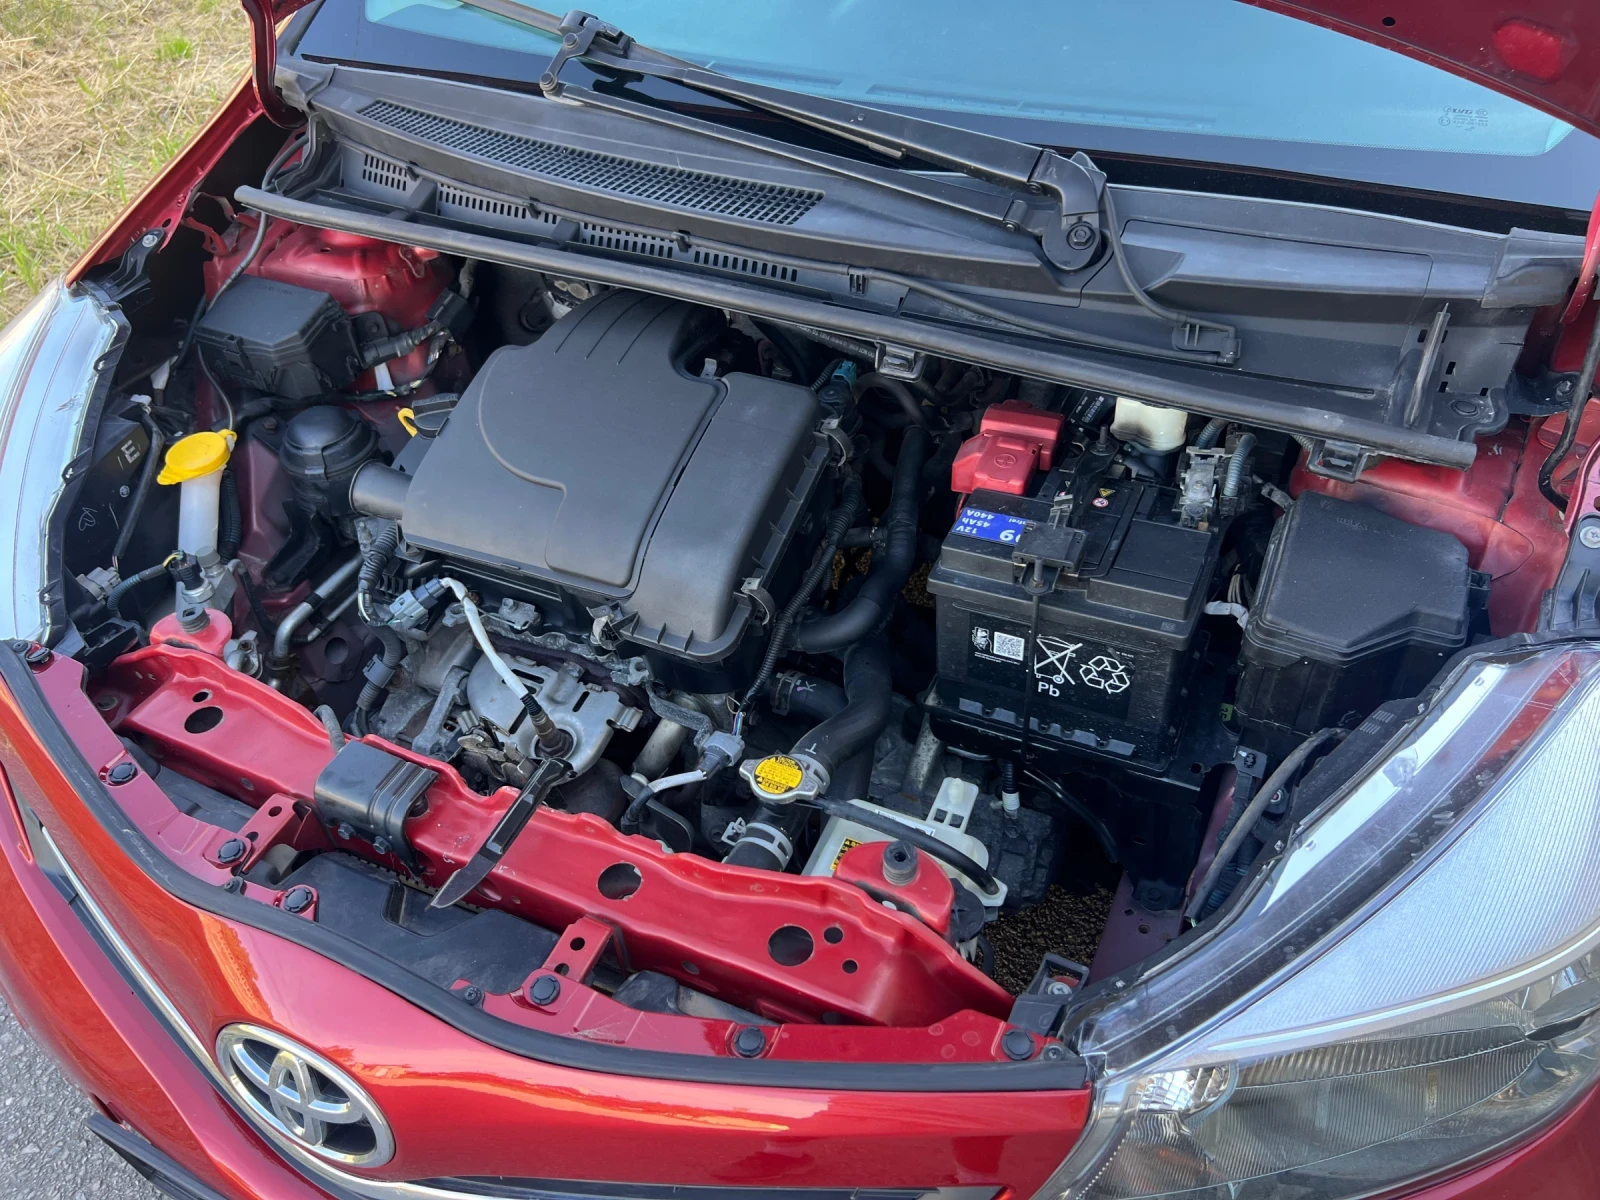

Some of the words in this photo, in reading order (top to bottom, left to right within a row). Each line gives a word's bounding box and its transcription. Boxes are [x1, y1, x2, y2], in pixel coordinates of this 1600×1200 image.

[966, 509, 995, 520] 440A
[961, 517, 991, 528] 45Ah
[956, 525, 978, 534] 12V
[999, 529, 1021, 543] 9
[1037, 681, 1060, 697] Pb
